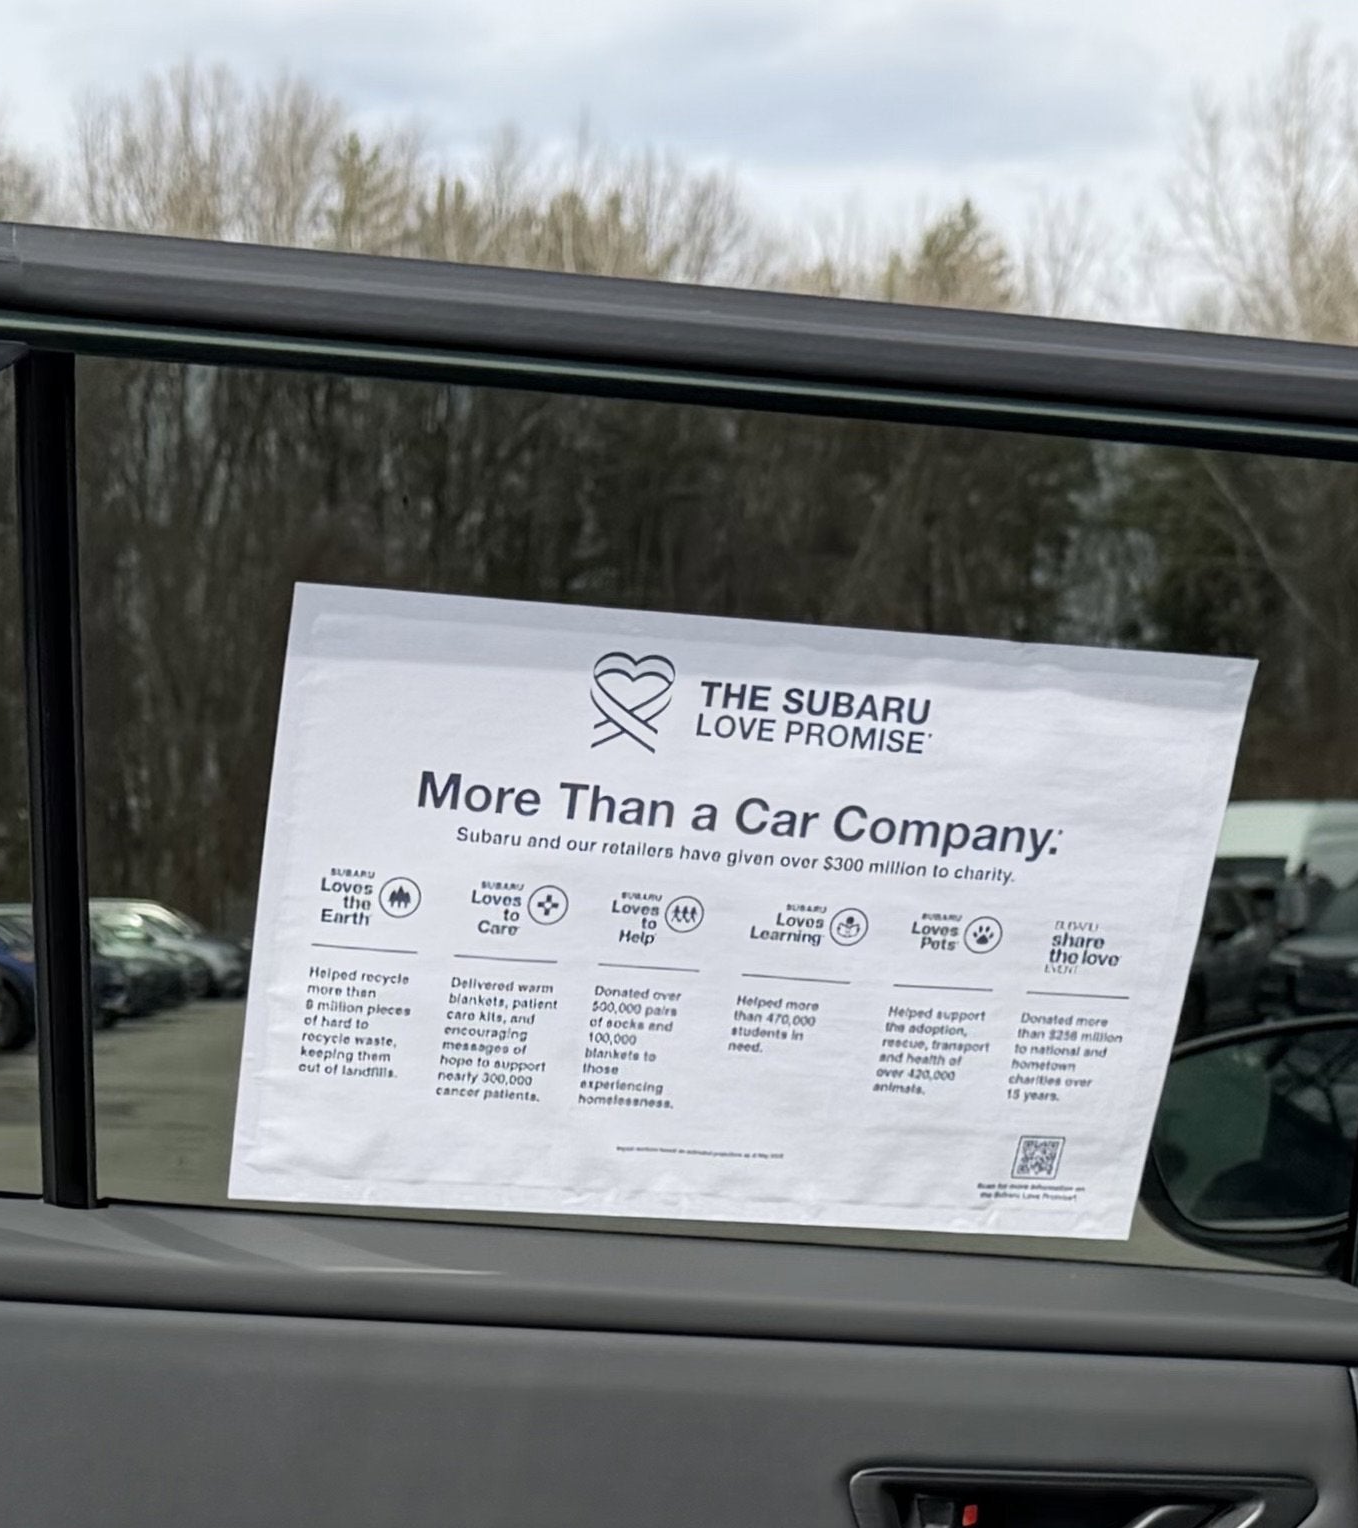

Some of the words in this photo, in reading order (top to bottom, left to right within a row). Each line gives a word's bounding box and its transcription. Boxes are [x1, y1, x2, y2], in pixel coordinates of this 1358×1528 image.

[699, 679, 773, 713] THE
[780, 686, 932, 726] SUBARU
[694, 711, 777, 743] LOVE
[783, 718, 928, 755] PROMISE
[417, 770, 541, 815] More
[558, 780, 675, 829] Than
[689, 802, 718, 832] a
[734, 796, 821, 839] Car
[832, 803, 1060, 863] Company.
[456, 826, 521, 846] Subaru
[526, 835, 561, 849] and
[566, 839, 597, 851] our
[601, 841, 673, 858] retailers
[679, 844, 721, 862] have
[726, 848, 774, 867] given
[779, 855, 818, 869] over
[822, 855, 864, 872] $300
[868, 860, 926, 876] million
[932, 864, 949, 878] to
[953, 865, 1014, 886] charity.
[330, 867, 375, 879] SUBARU
[320, 876, 373, 896] Loves
[342, 895, 371, 910] the
[470, 889, 521, 909] Loves
[320, 907, 370, 926] Earth
[503, 908, 519, 921] to
[611, 899, 659, 918] Loves
[477, 919, 519, 936] Care
[641, 917, 657, 930] to
[775, 912, 824, 929] Loves
[910, 920, 958, 937] Loves
[618, 929, 656, 946] Help
[749, 925, 824, 946] Learning
[920, 935, 958, 951] Pets
[1051, 931, 1105, 950] share
[1048, 948, 1079, 964] the
[1081, 948, 1119, 966] love
